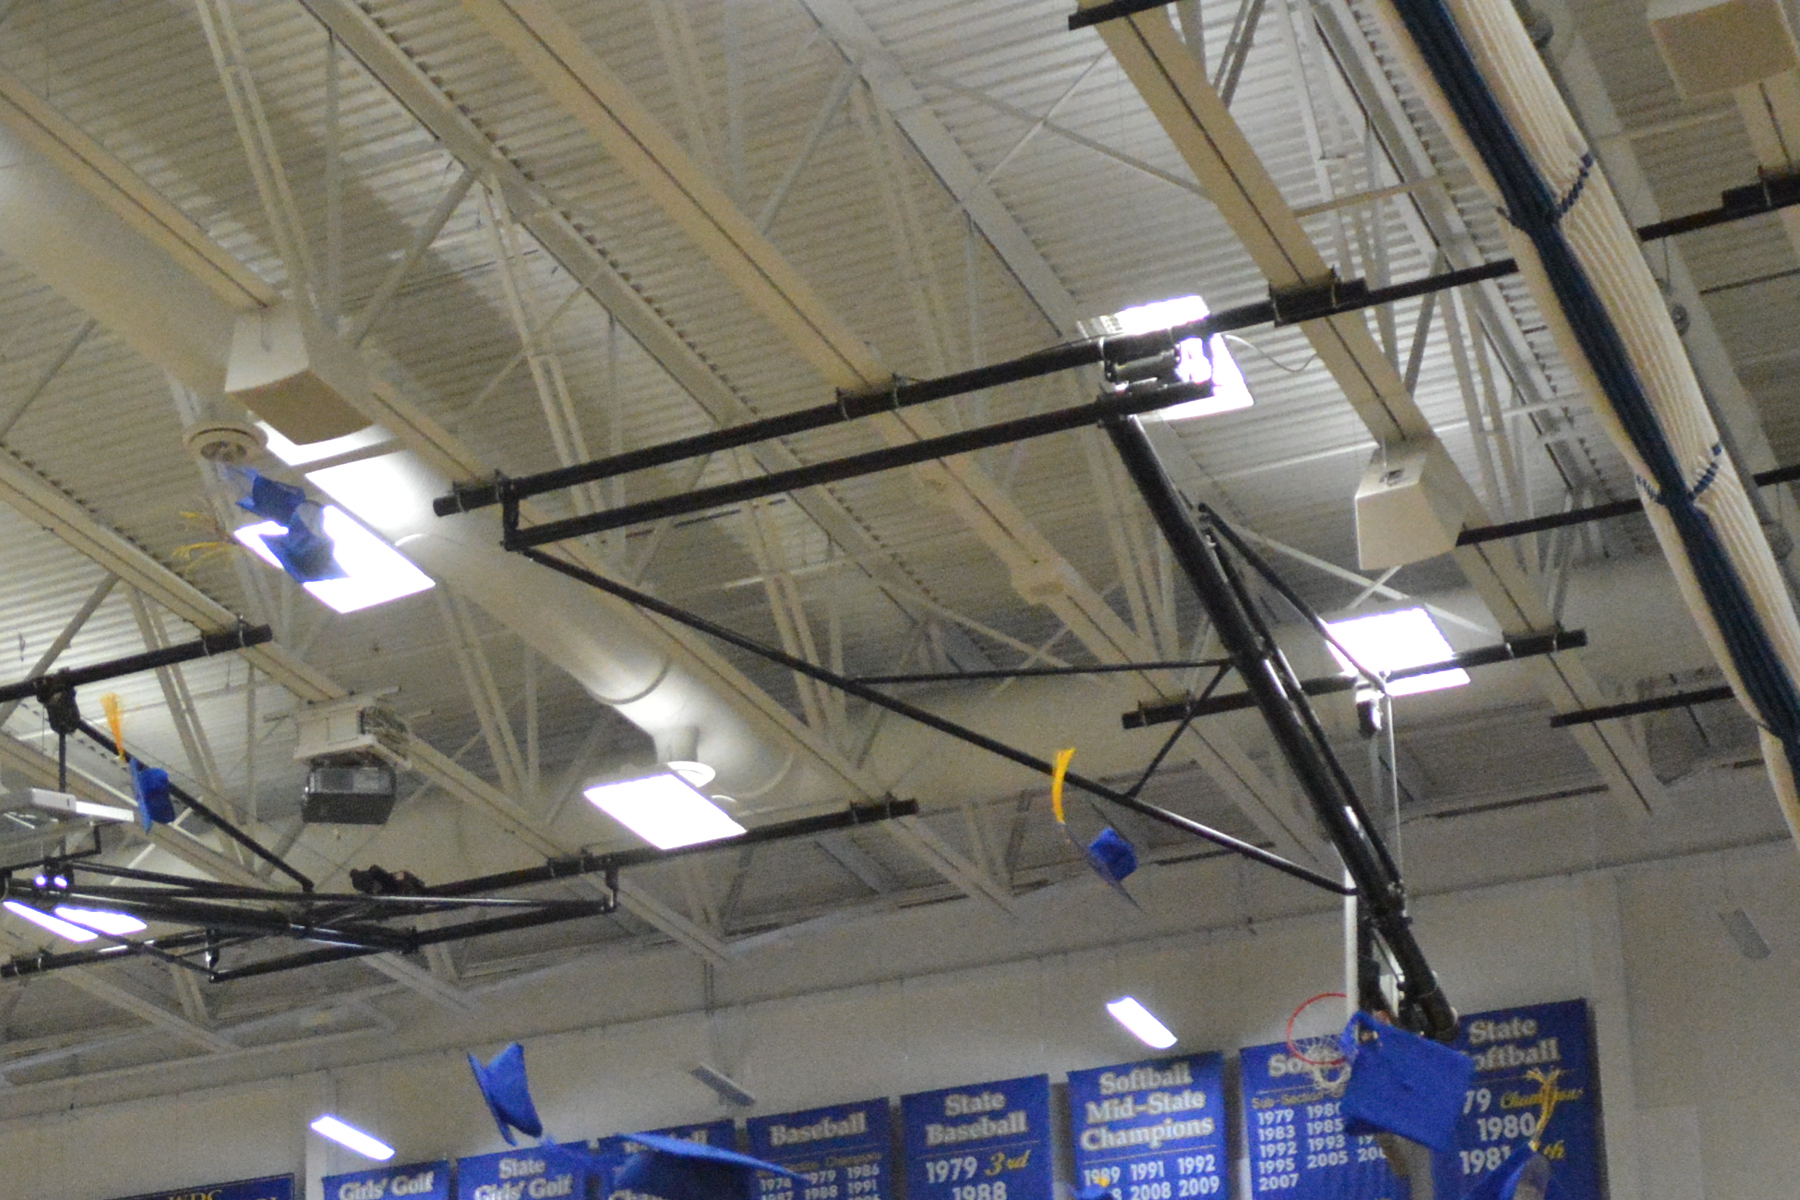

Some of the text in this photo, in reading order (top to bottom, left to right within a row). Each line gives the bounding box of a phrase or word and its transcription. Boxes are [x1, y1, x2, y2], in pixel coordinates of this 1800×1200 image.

[1468, 1016, 1538, 1046] State
[1099, 1061, 1193, 1095] Softball
[944, 1091, 1007, 1117] State
[1086, 1089, 1206, 1125] Mid-State
[1258, 1108, 1295, 1126] 1979
[770, 1111, 867, 1147] Baseball
[925, 1110, 1029, 1146] Baseball
[1080, 1116, 1215, 1151] Champions
[1258, 1118, 1344, 1142] 1983 1985
[1477, 1112, 1536, 1141] 1980
[1259, 1141, 1298, 1159] 1992
[1307, 1134, 1346, 1152] 1993
[499, 1157, 546, 1179] State
[926, 1150, 1031, 1184] 1979 3rd
[1130, 1161, 1164, 1181] 1991
[1177, 1154, 1216, 1175] 1992
[1258, 1150, 1348, 1175] 1995 2005
[390, 1171, 435, 1196] Golf
[528, 1173, 573, 1199] Golf
[1178, 1175, 1220, 1197] 2009
[1258, 1173, 1299, 1192] 2007
